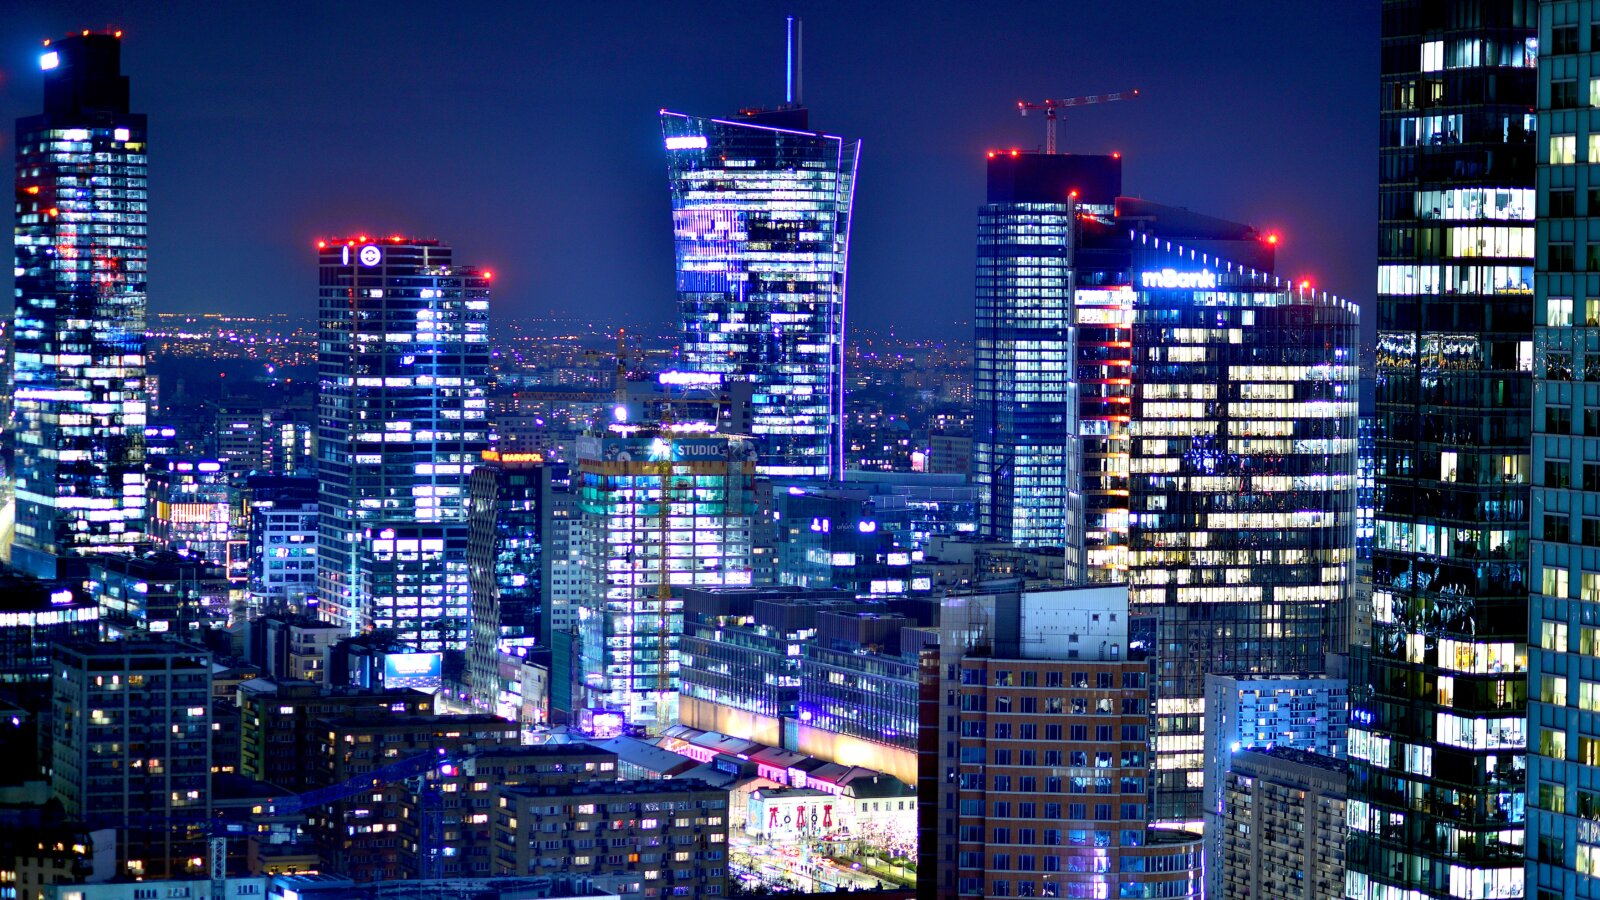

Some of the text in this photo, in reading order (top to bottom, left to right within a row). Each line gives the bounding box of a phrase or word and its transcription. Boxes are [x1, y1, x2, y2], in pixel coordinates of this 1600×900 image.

[1142, 268, 1215, 288] mBank
[678, 444, 718, 456] STUDIO
[502, 453, 544, 462] MARVIPOL
